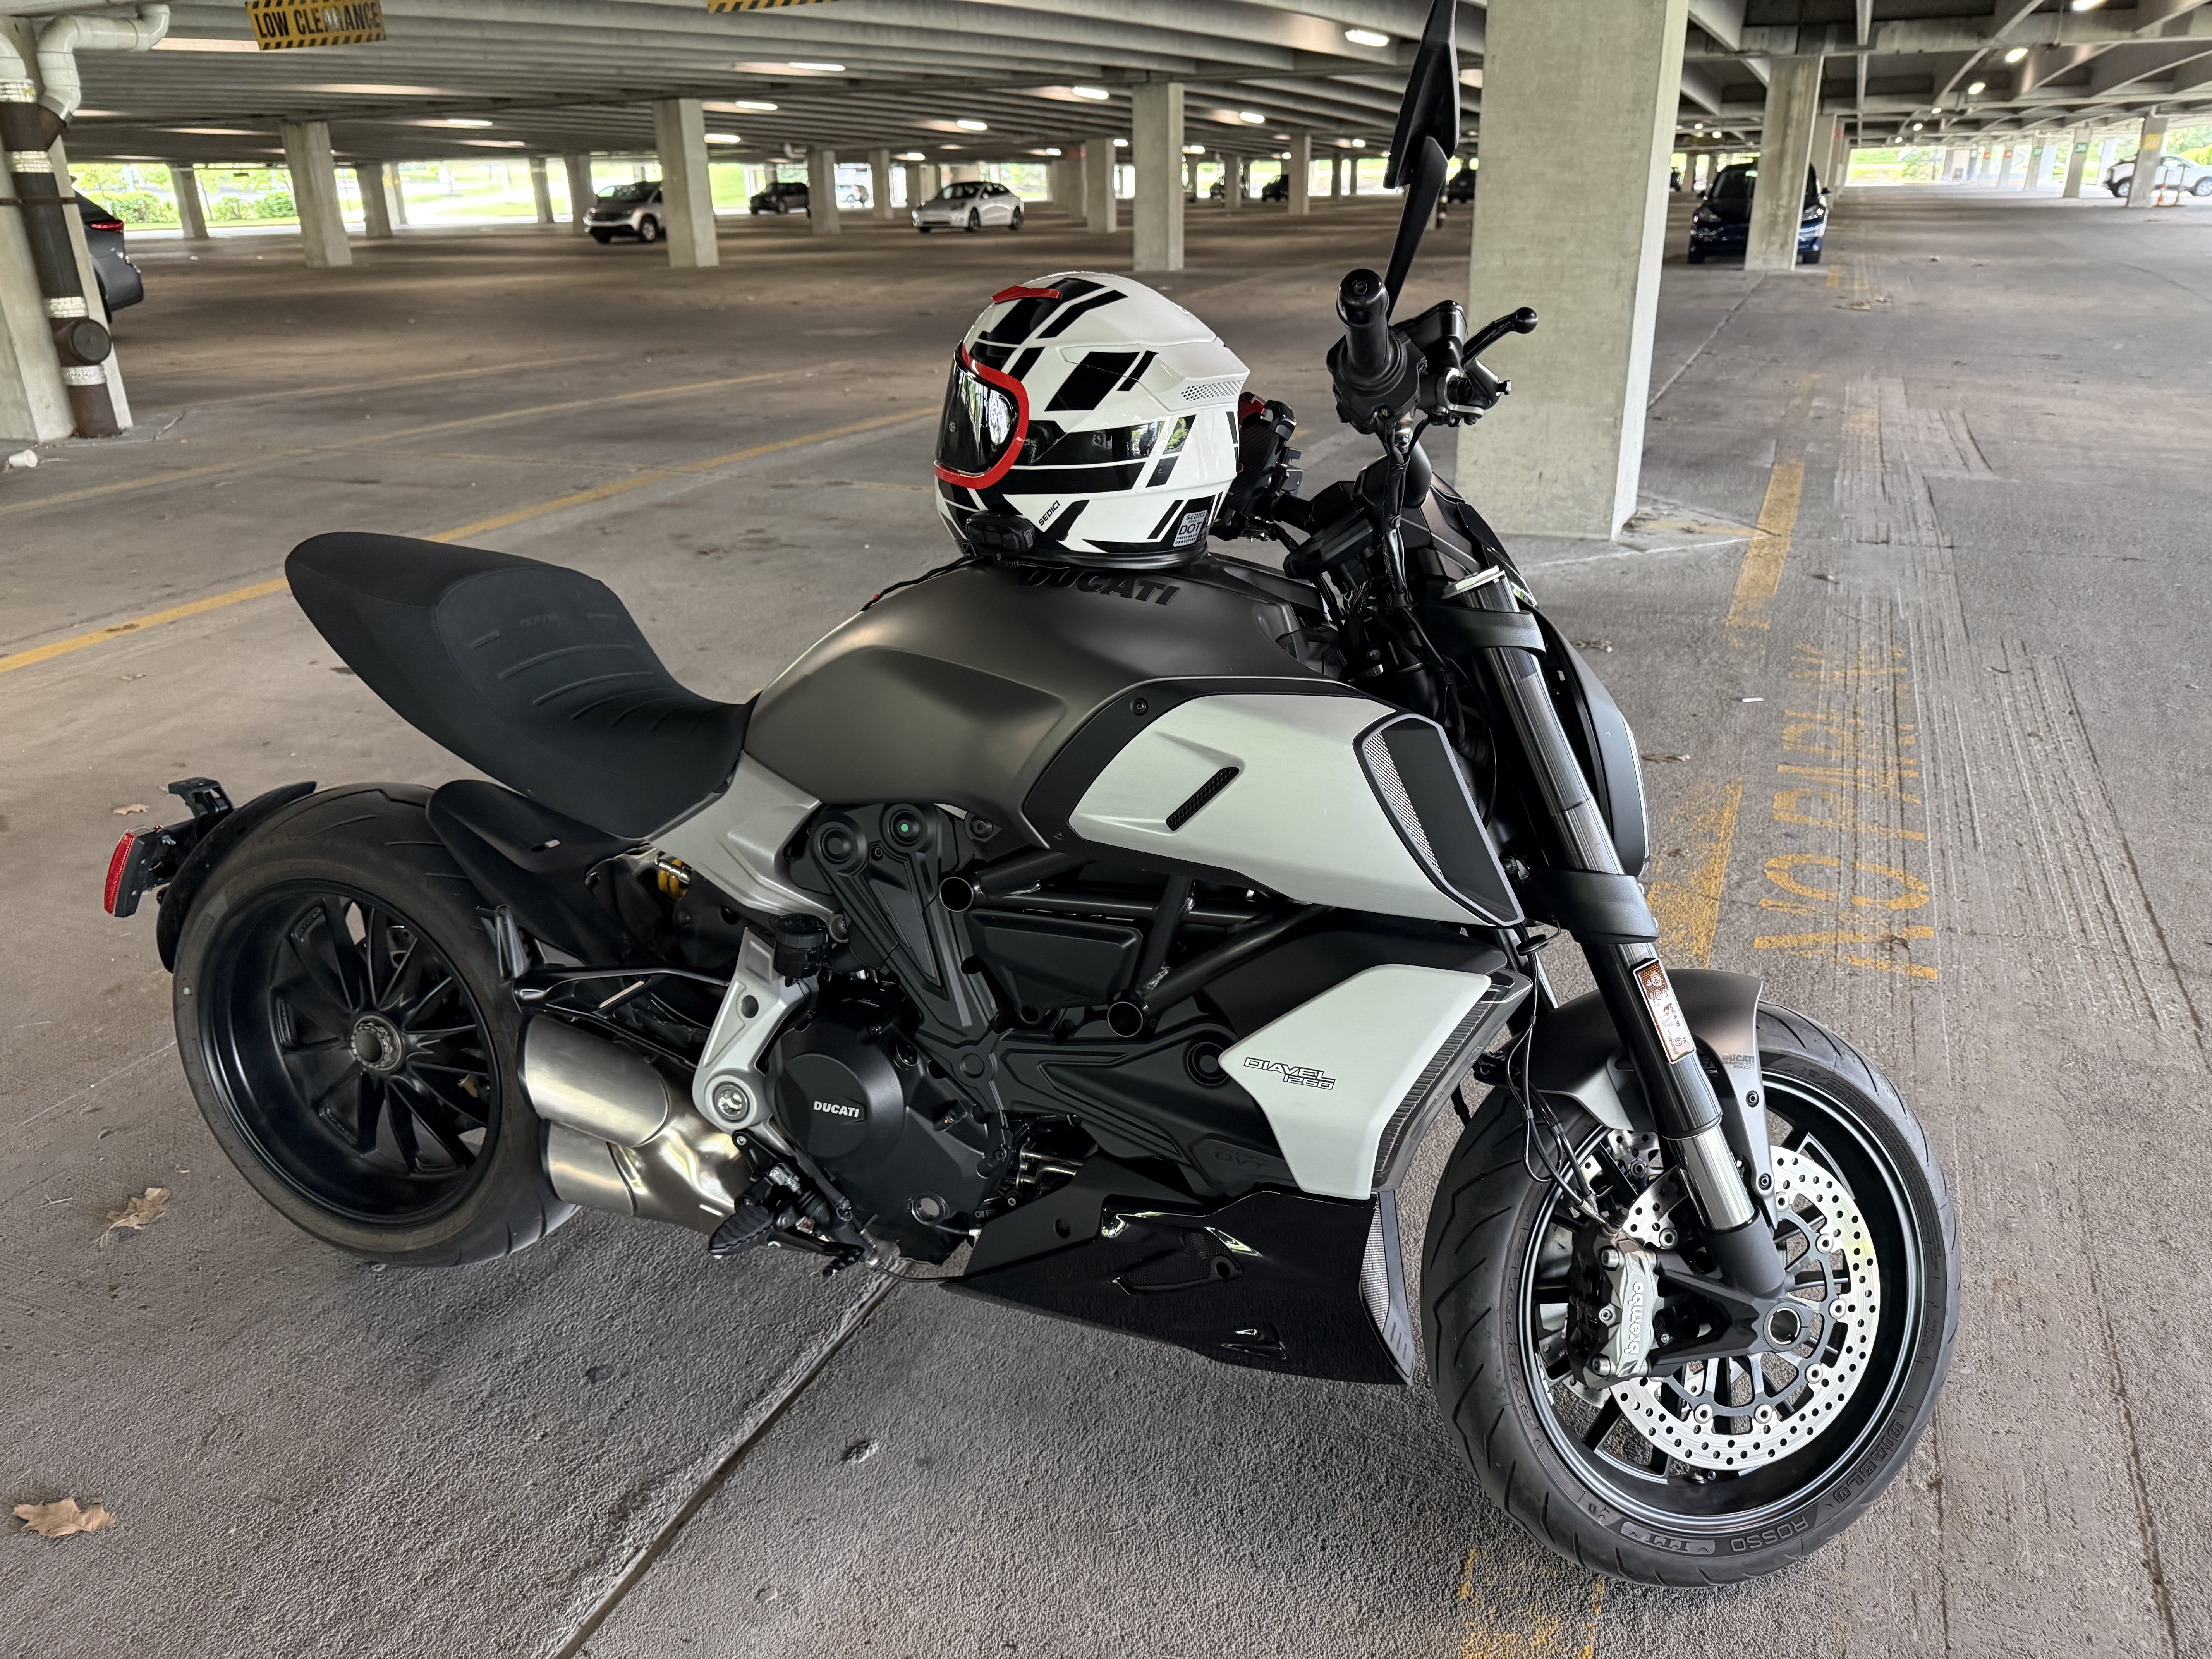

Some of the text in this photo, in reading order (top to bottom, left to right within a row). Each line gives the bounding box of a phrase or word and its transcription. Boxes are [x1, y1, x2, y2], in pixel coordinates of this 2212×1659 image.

[254, 2, 380, 38] LOW CLEARANCE
[1038, 500, 1060, 526] SEDICI
[1178, 521, 1203, 535] DOT
[1186, 511, 1206, 520] SEDICI
[1020, 570, 1181, 606] DUCATI
[1772, 640, 1927, 842] PARN
[1754, 854, 1937, 981] NO
[1243, 1057, 1336, 1083] DIAVEL
[1721, 1054, 1755, 1063] DUCATI
[1283, 1073, 1335, 1090] 1260
[813, 1101, 859, 1118] DUCATI
[1624, 1281, 1644, 1354] brembo
[1834, 1421, 1904, 1503] DIABLO
[1731, 1515, 1808, 1552] ROSSO
